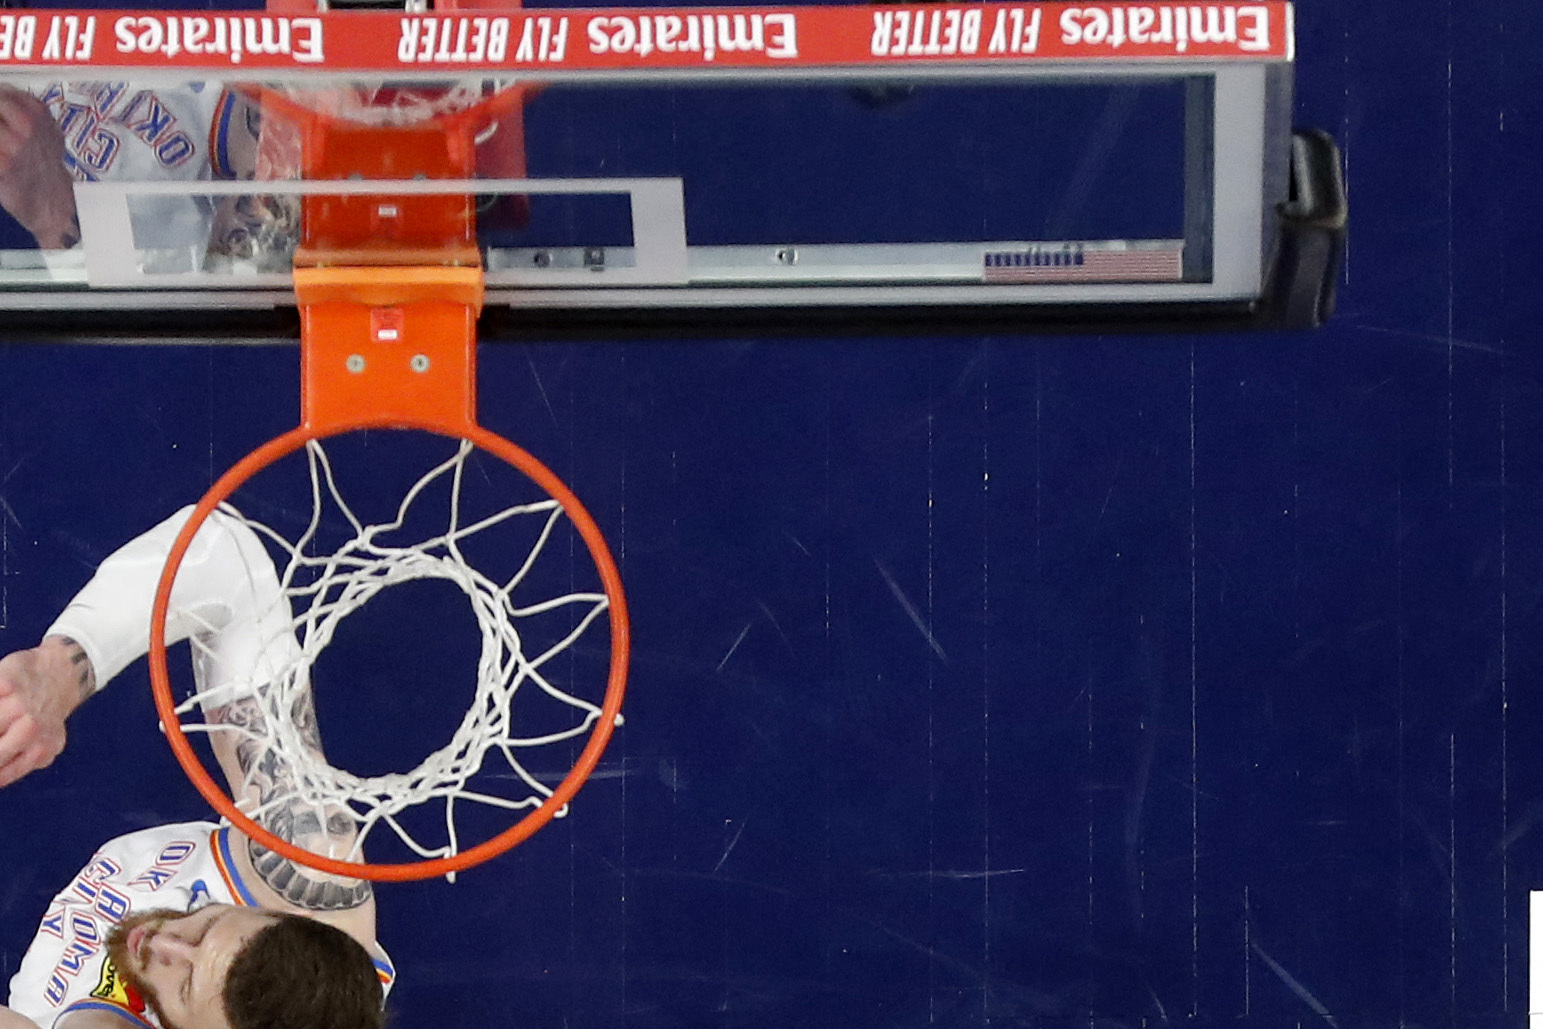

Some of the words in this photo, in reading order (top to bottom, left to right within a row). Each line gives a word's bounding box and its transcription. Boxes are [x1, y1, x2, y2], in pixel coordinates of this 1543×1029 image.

[41, 15, 96, 61] FLY
[114, 14, 327, 63] Emirates
[397, 17, 510, 64] BETTER
[515, 16, 569, 63] FLY
[587, 13, 800, 62] Emirates
[870, 9, 983, 56] BETTER
[987, 8, 1042, 54] FLY
[1059, 6, 1271, 52] Emirates
[40, 852, 123, 940] CIY
[42, 840, 197, 1008] OKAOMA
